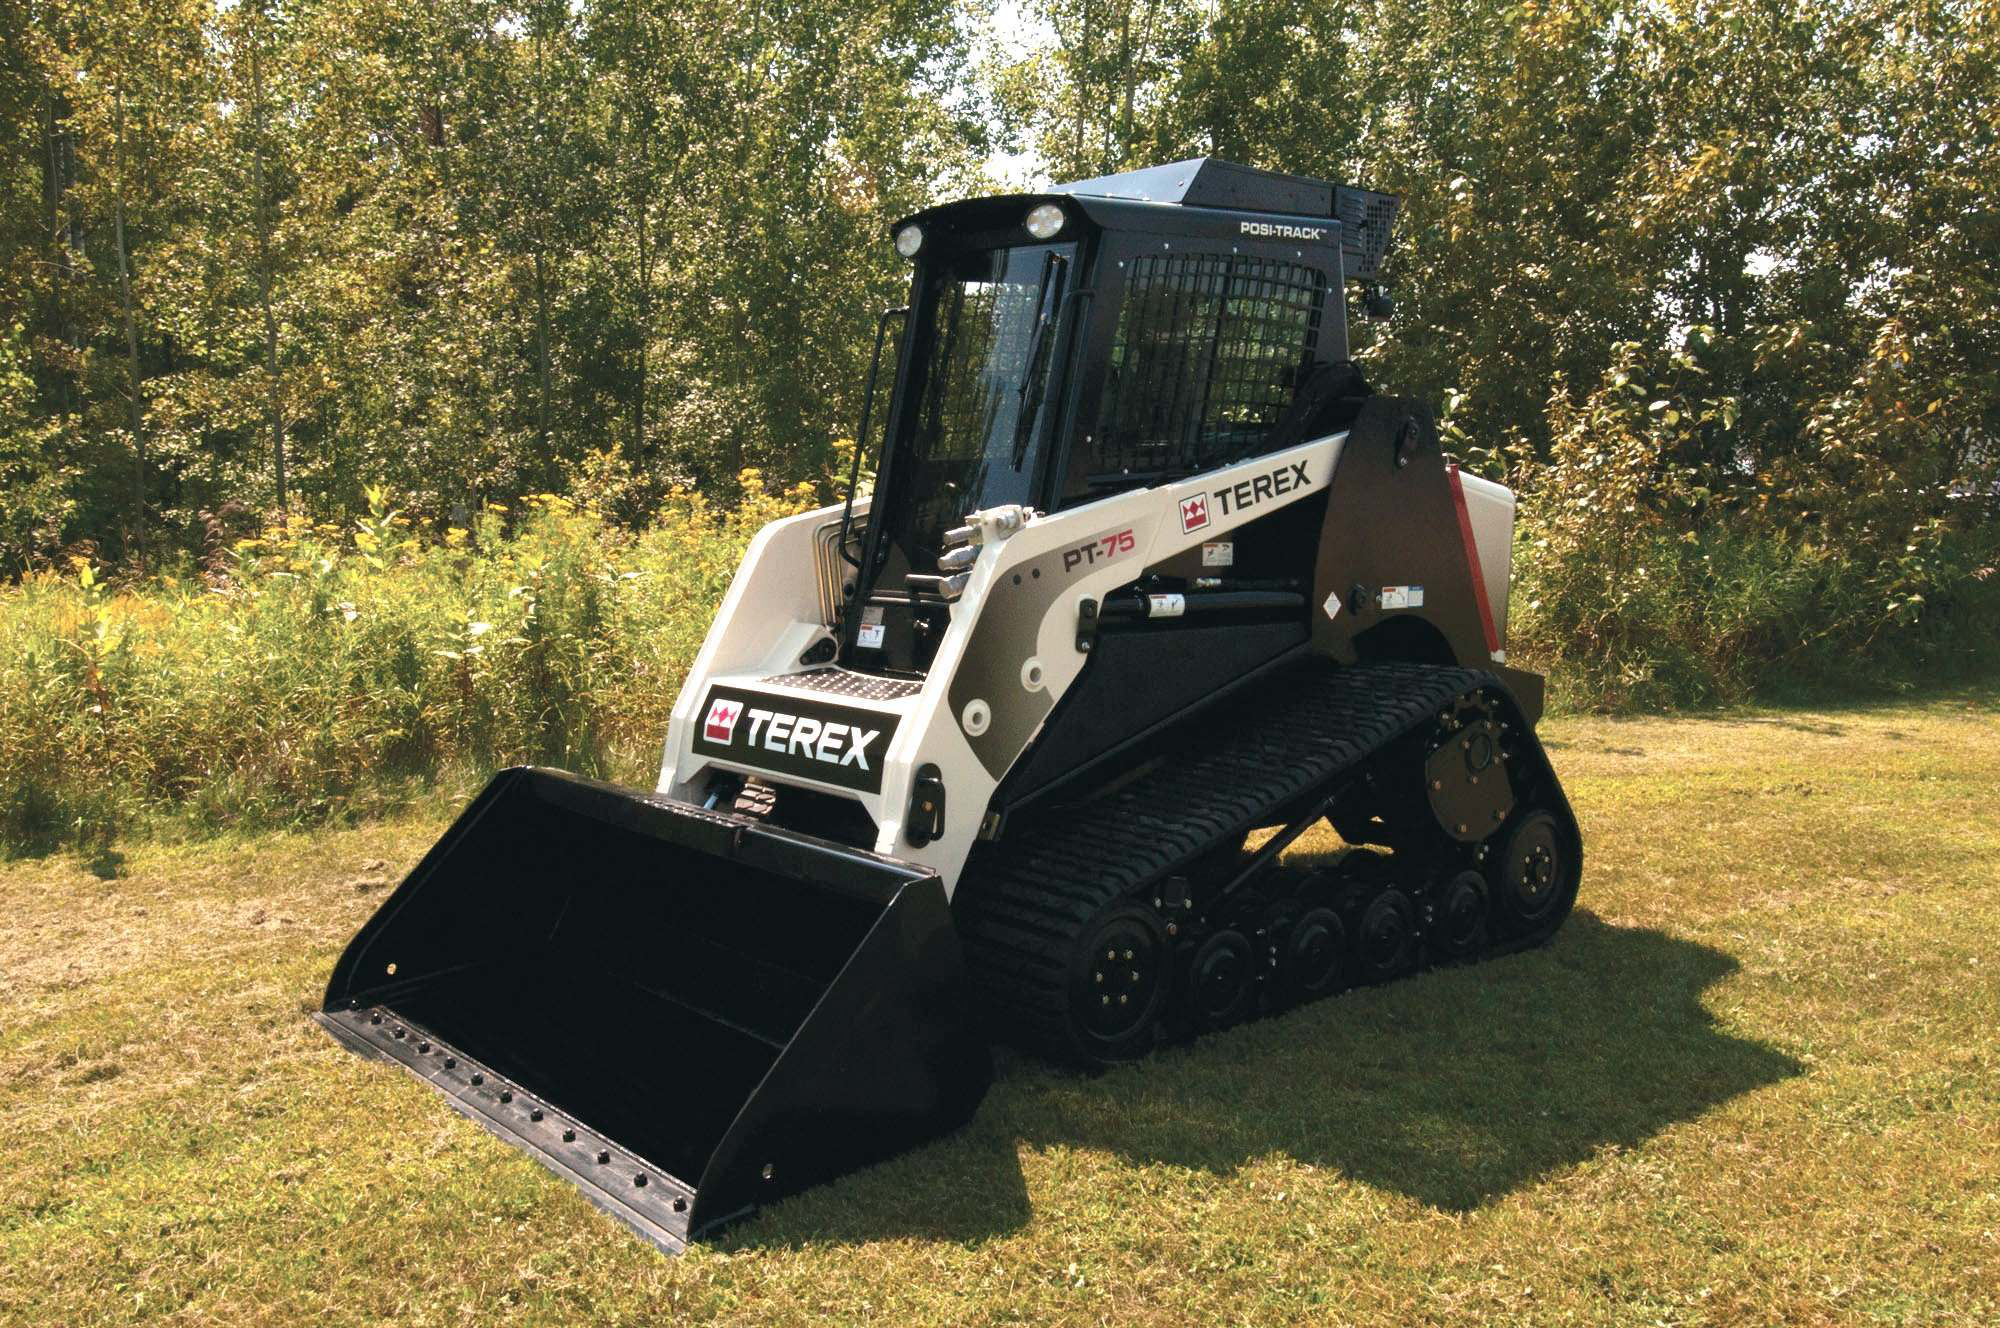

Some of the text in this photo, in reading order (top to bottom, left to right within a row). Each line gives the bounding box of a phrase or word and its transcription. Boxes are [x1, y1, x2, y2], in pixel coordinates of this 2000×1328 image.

[1240, 221, 1320, 240] POSI-TRACK
[1213, 459, 1312, 516] TEREX
[1063, 528, 1136, 573] PT-75
[747, 708, 881, 772] TEREX
